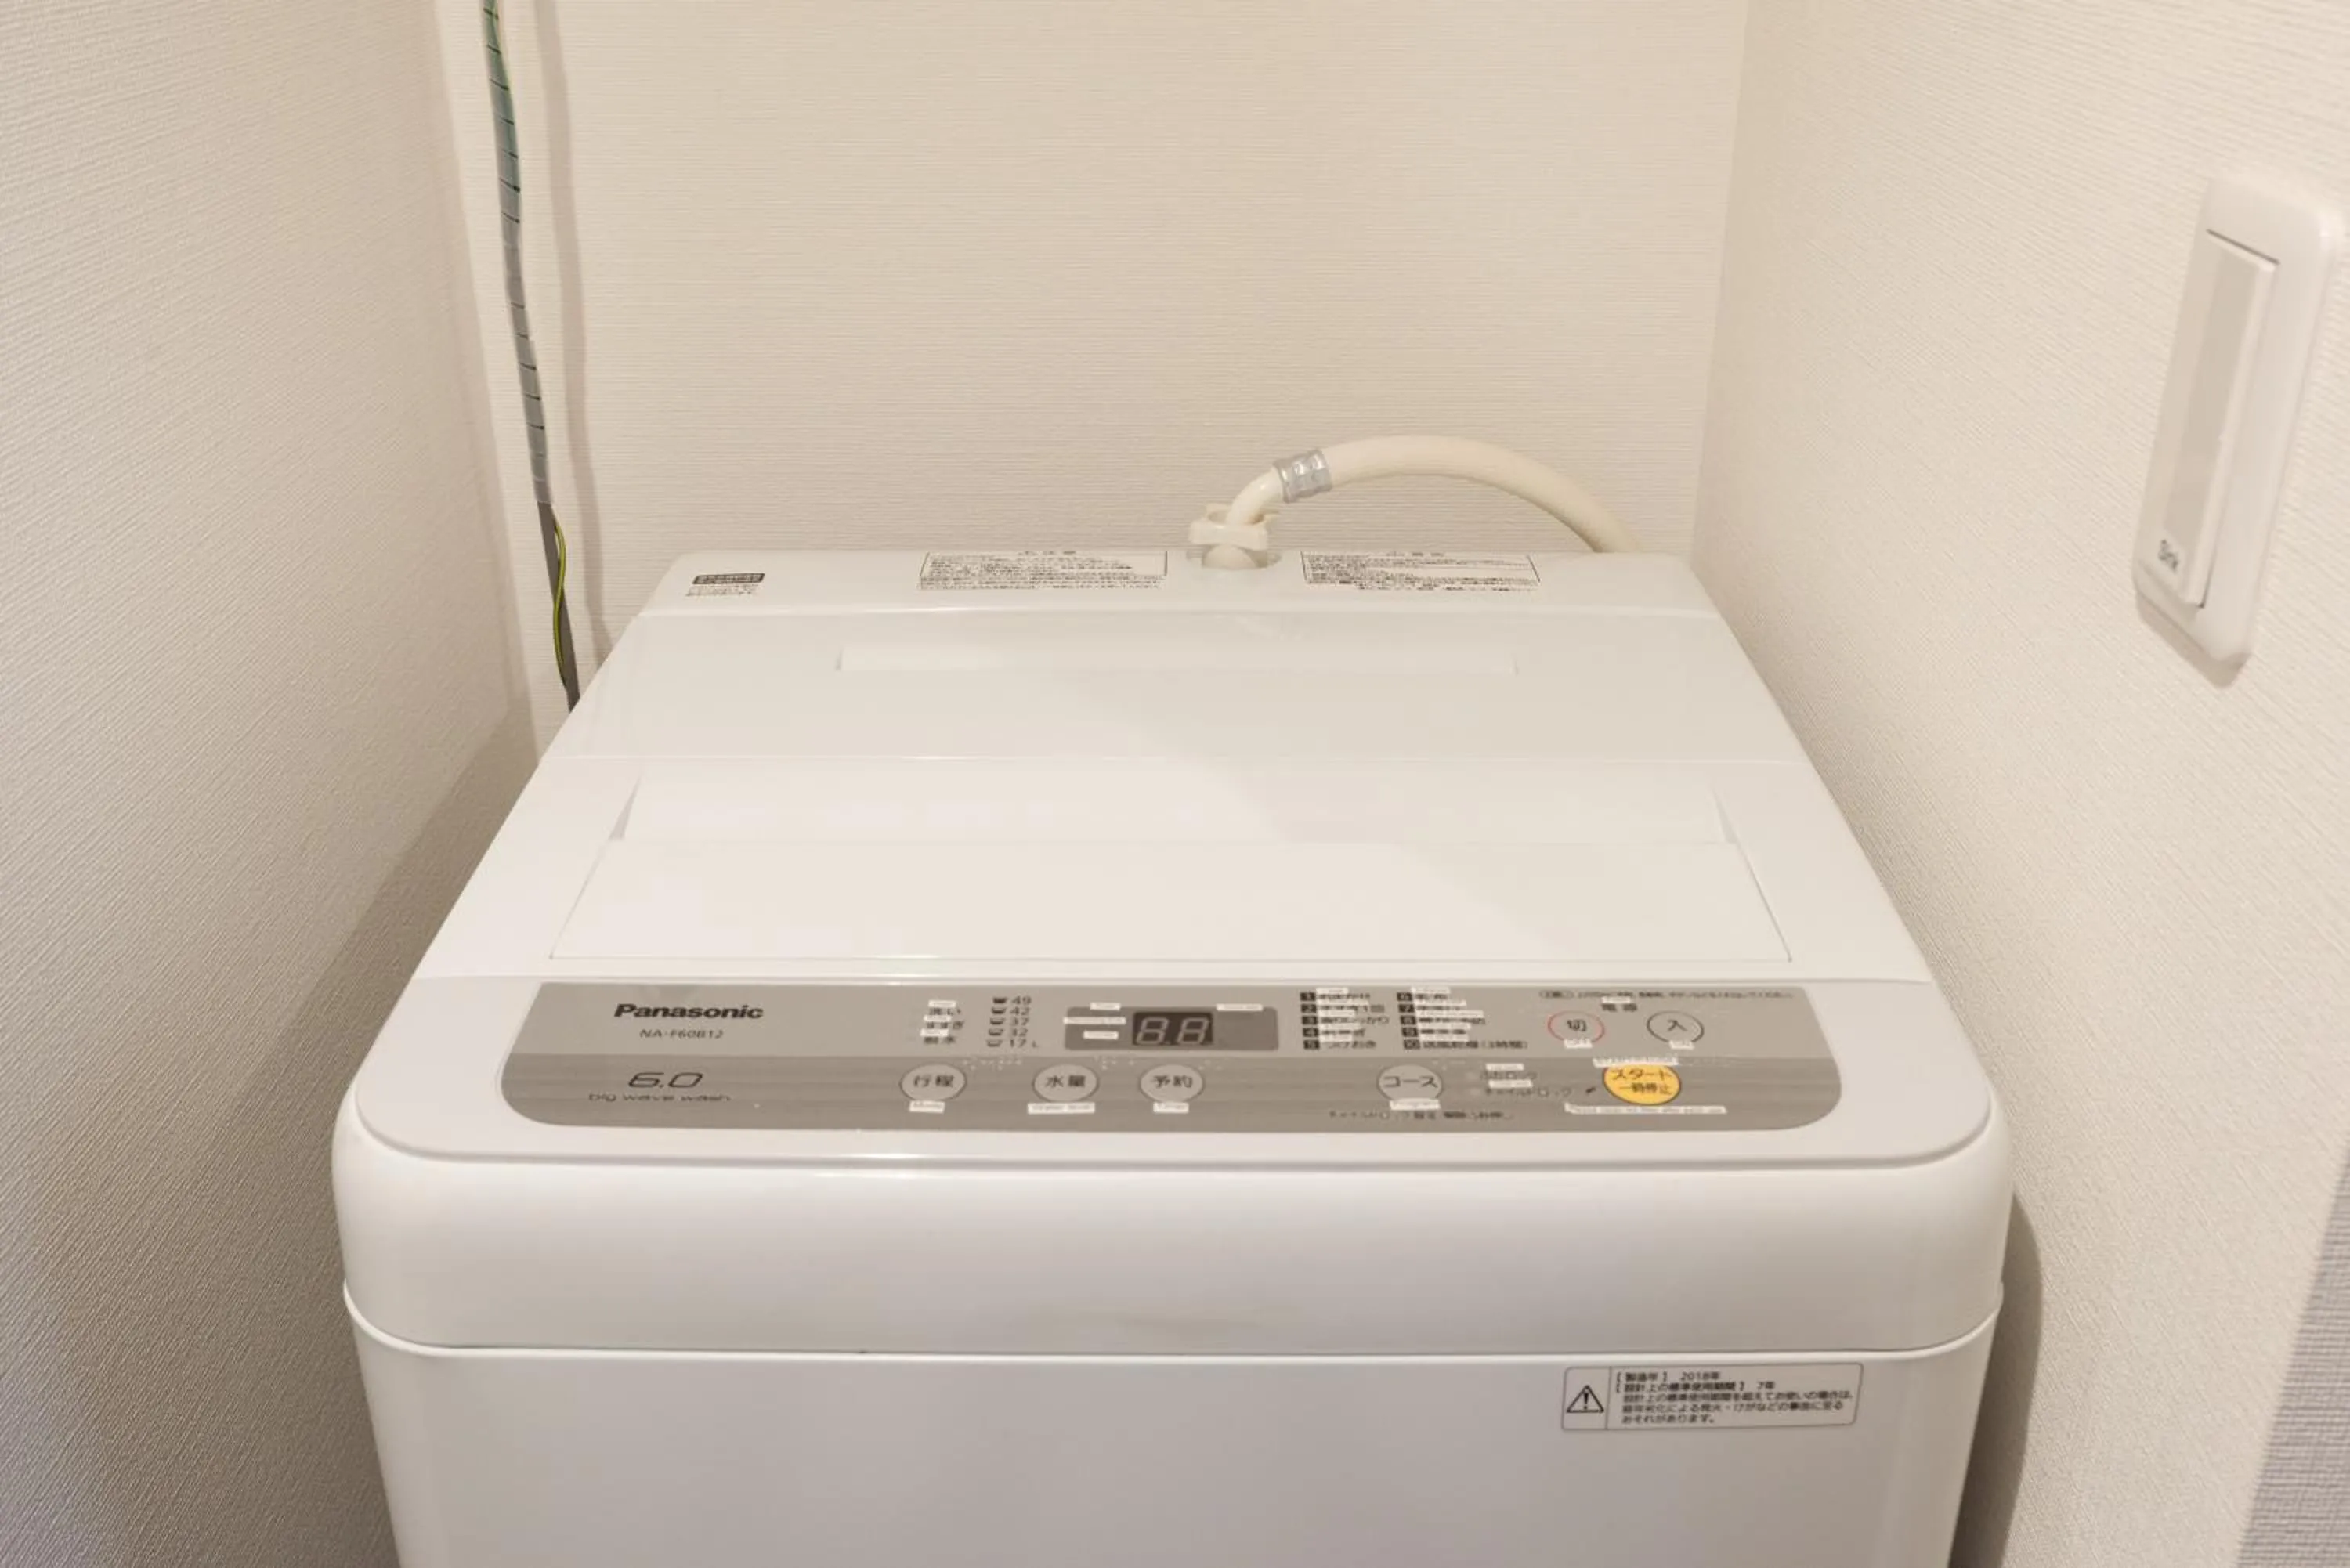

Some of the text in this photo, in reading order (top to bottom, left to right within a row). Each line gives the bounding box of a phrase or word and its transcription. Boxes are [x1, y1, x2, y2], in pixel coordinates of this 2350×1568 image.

[1011, 995, 1032, 1004] 49
[614, 1003, 764, 1019] Panasonic
[1667, 1019, 1688, 1032] 入
[640, 1029, 724, 1039] NA-F60B12
[1010, 1039, 1027, 1048] 17
[628, 1072, 703, 1088] 6.0
[1611, 1068, 1674, 1080] スタート
[1153, 1075, 1194, 1088] 予約
[1383, 1075, 1438, 1088] コース
